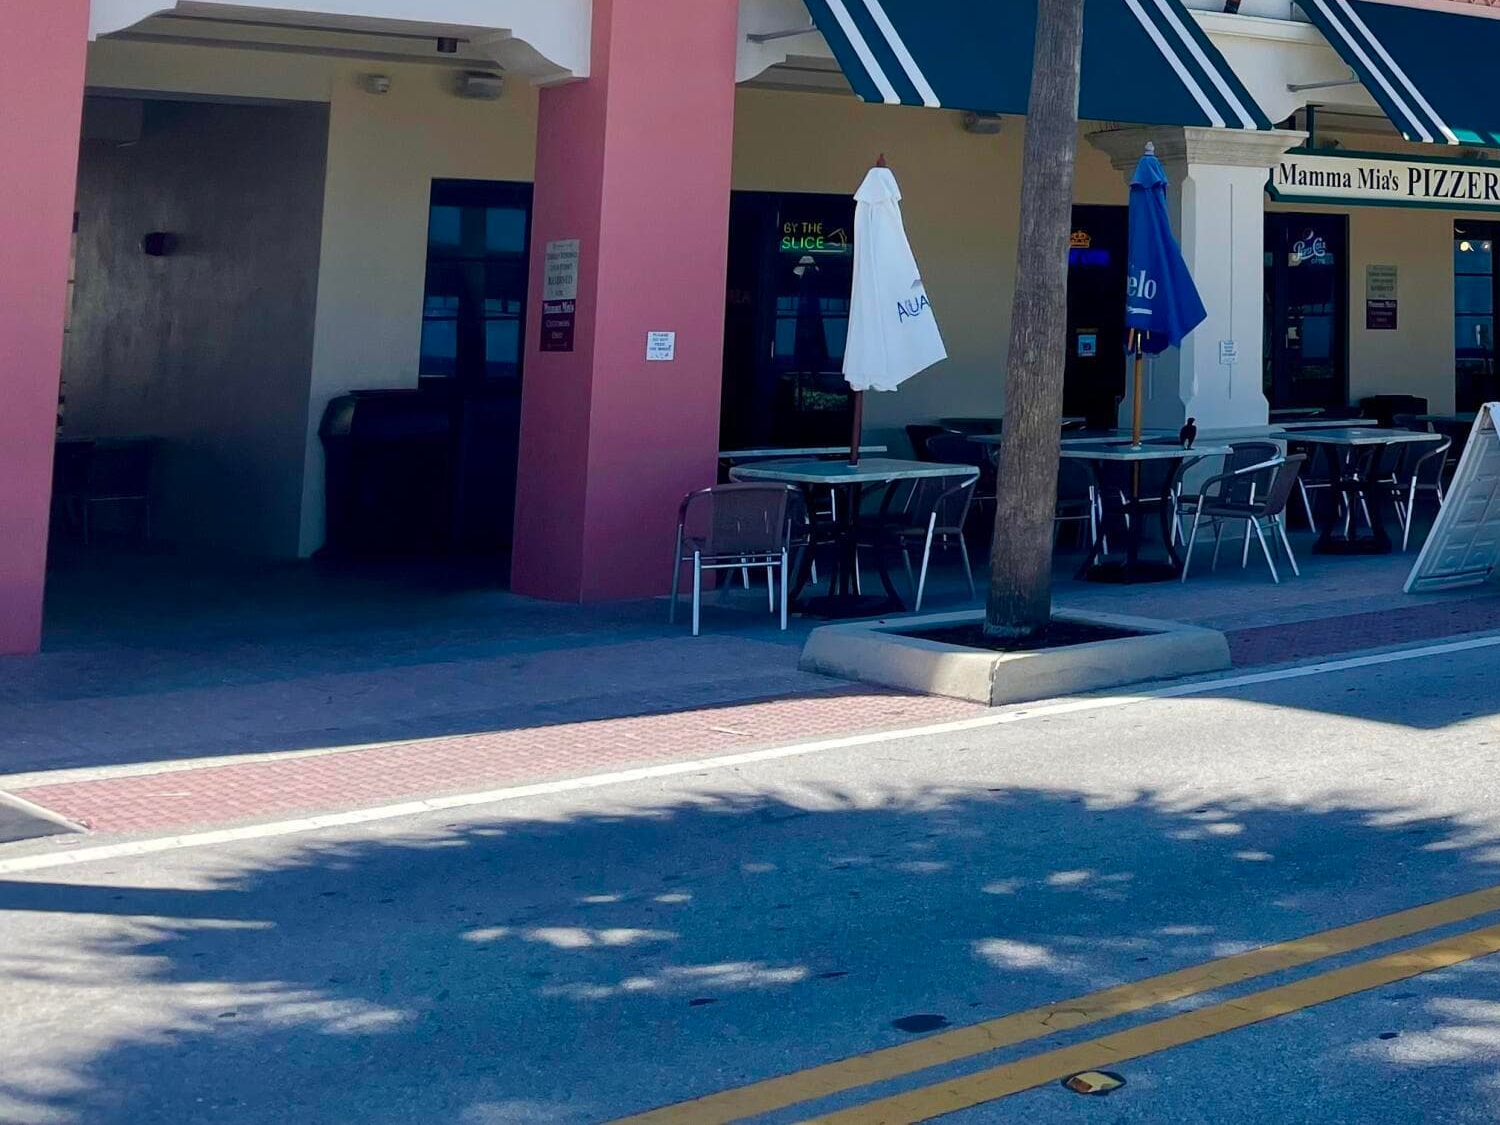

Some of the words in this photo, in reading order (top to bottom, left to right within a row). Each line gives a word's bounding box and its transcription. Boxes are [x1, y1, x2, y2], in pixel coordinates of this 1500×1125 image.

[1279, 162, 1352, 188] Mamma
[1357, 167, 1399, 191] Mia's
[783, 222, 798, 234] BY
[801, 221, 823, 234] THE
[782, 236, 825, 249] SLICE
[1127, 269, 1157, 300] elo
